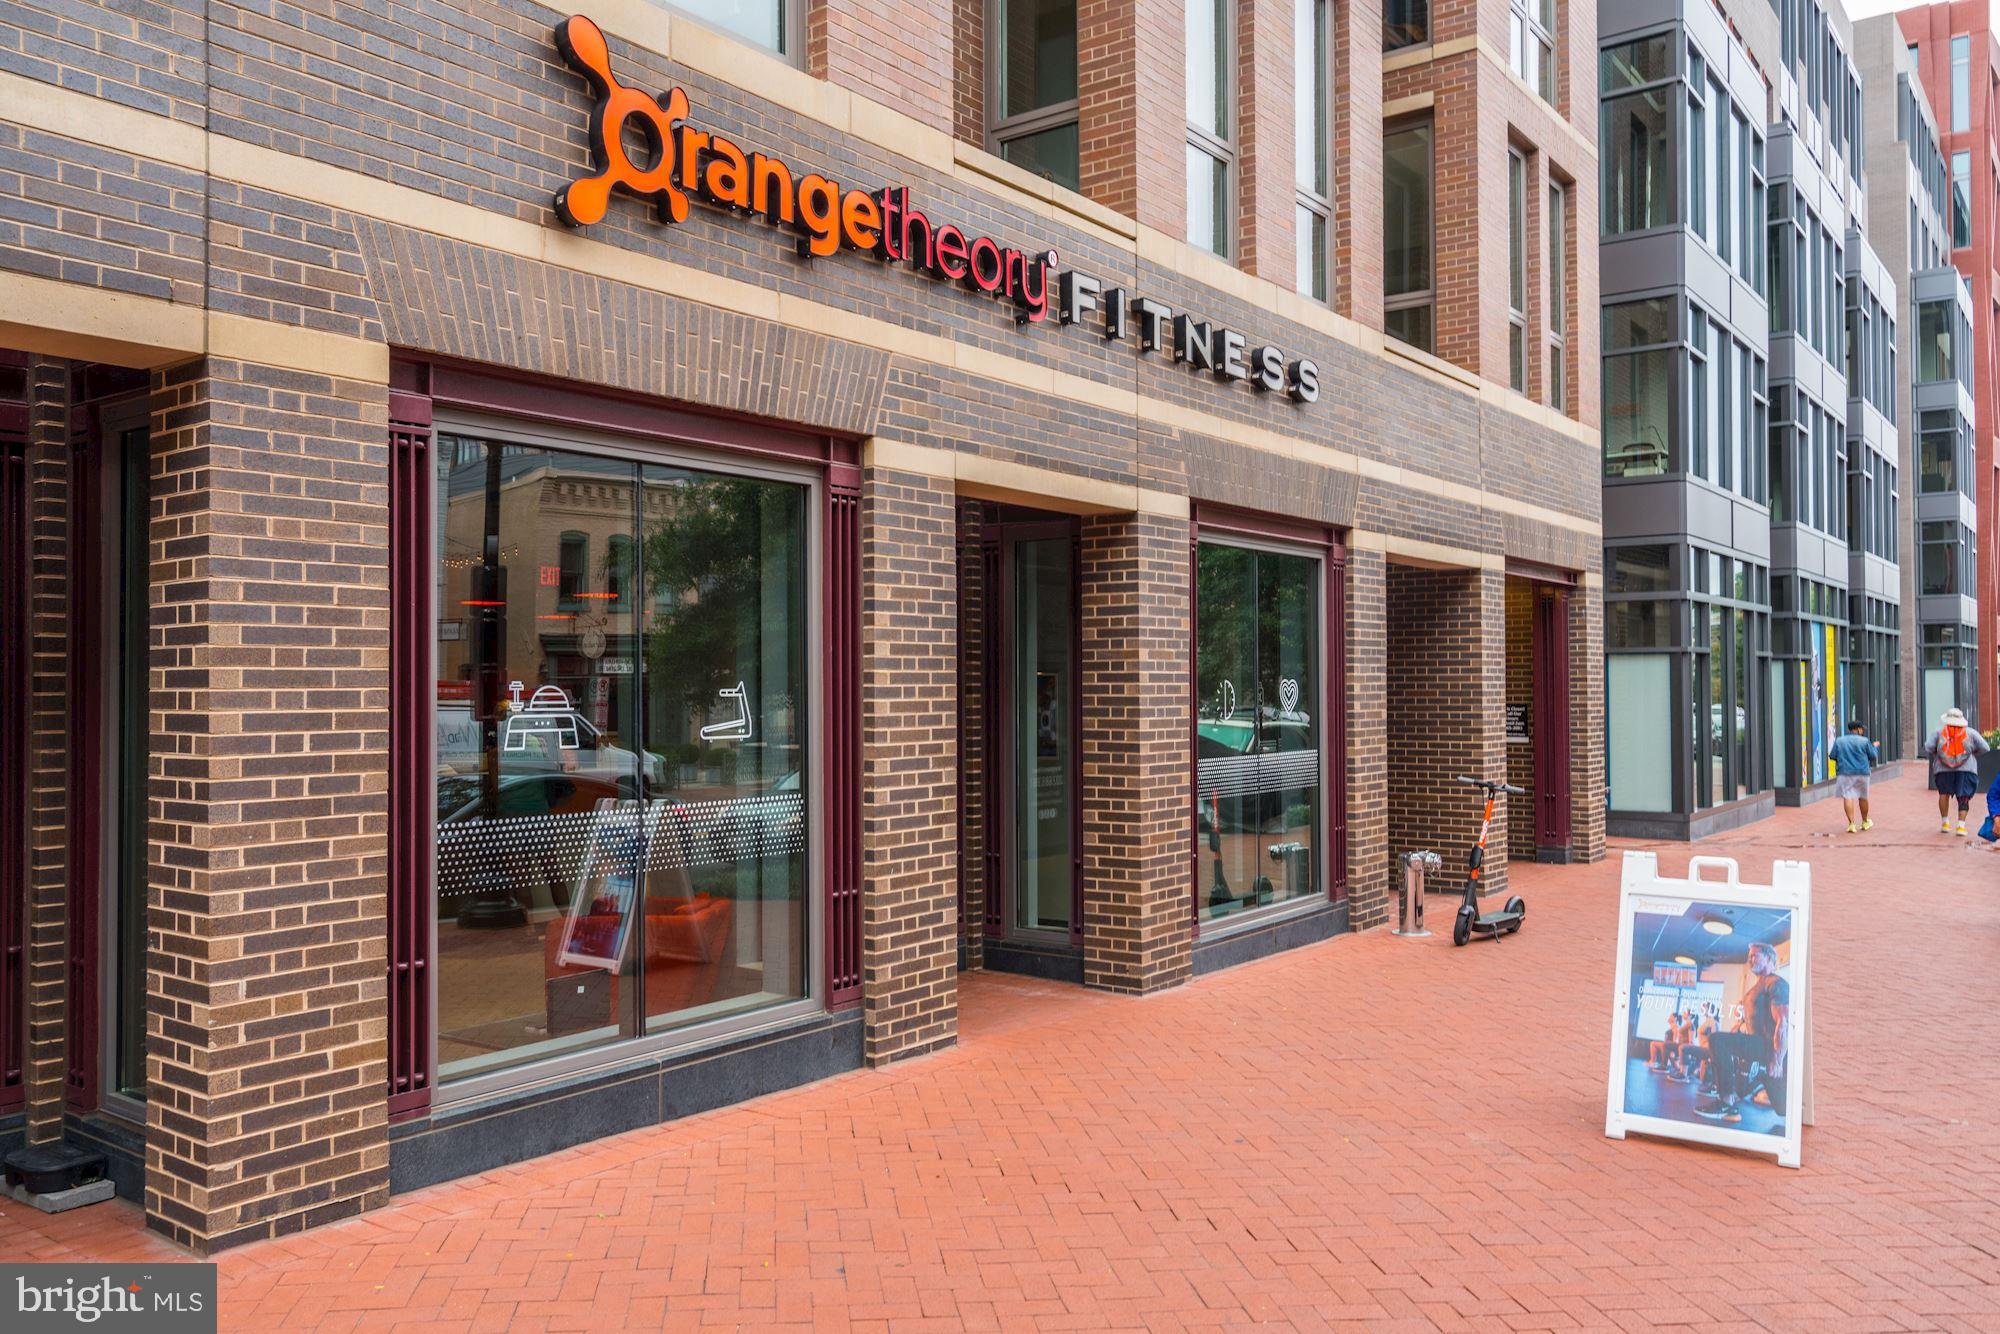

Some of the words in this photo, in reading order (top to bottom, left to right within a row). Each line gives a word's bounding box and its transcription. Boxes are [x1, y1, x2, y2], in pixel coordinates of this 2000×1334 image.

[1061, 270, 1320, 402] FITNESS
[541, 566, 560, 586] EXIT
[1637, 994, 1674, 1009] YOUR
[1679, 999, 1745, 1020] RESULTS
